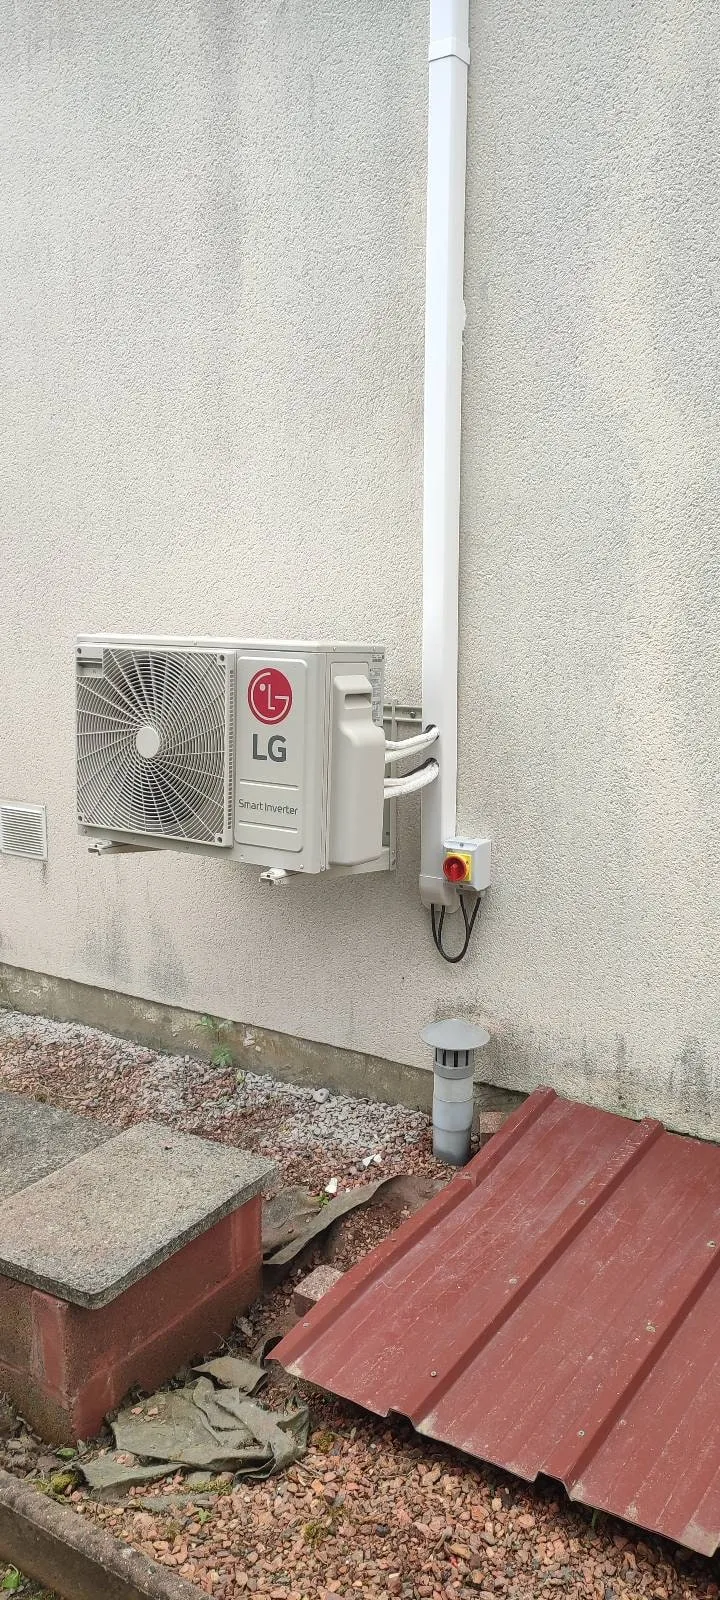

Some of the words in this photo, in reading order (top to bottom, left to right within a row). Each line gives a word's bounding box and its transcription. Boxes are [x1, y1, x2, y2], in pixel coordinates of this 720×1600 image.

[252, 733, 287, 763] LG
[238, 798, 263, 811] Smart
[264, 802, 299, 816] Inverter
